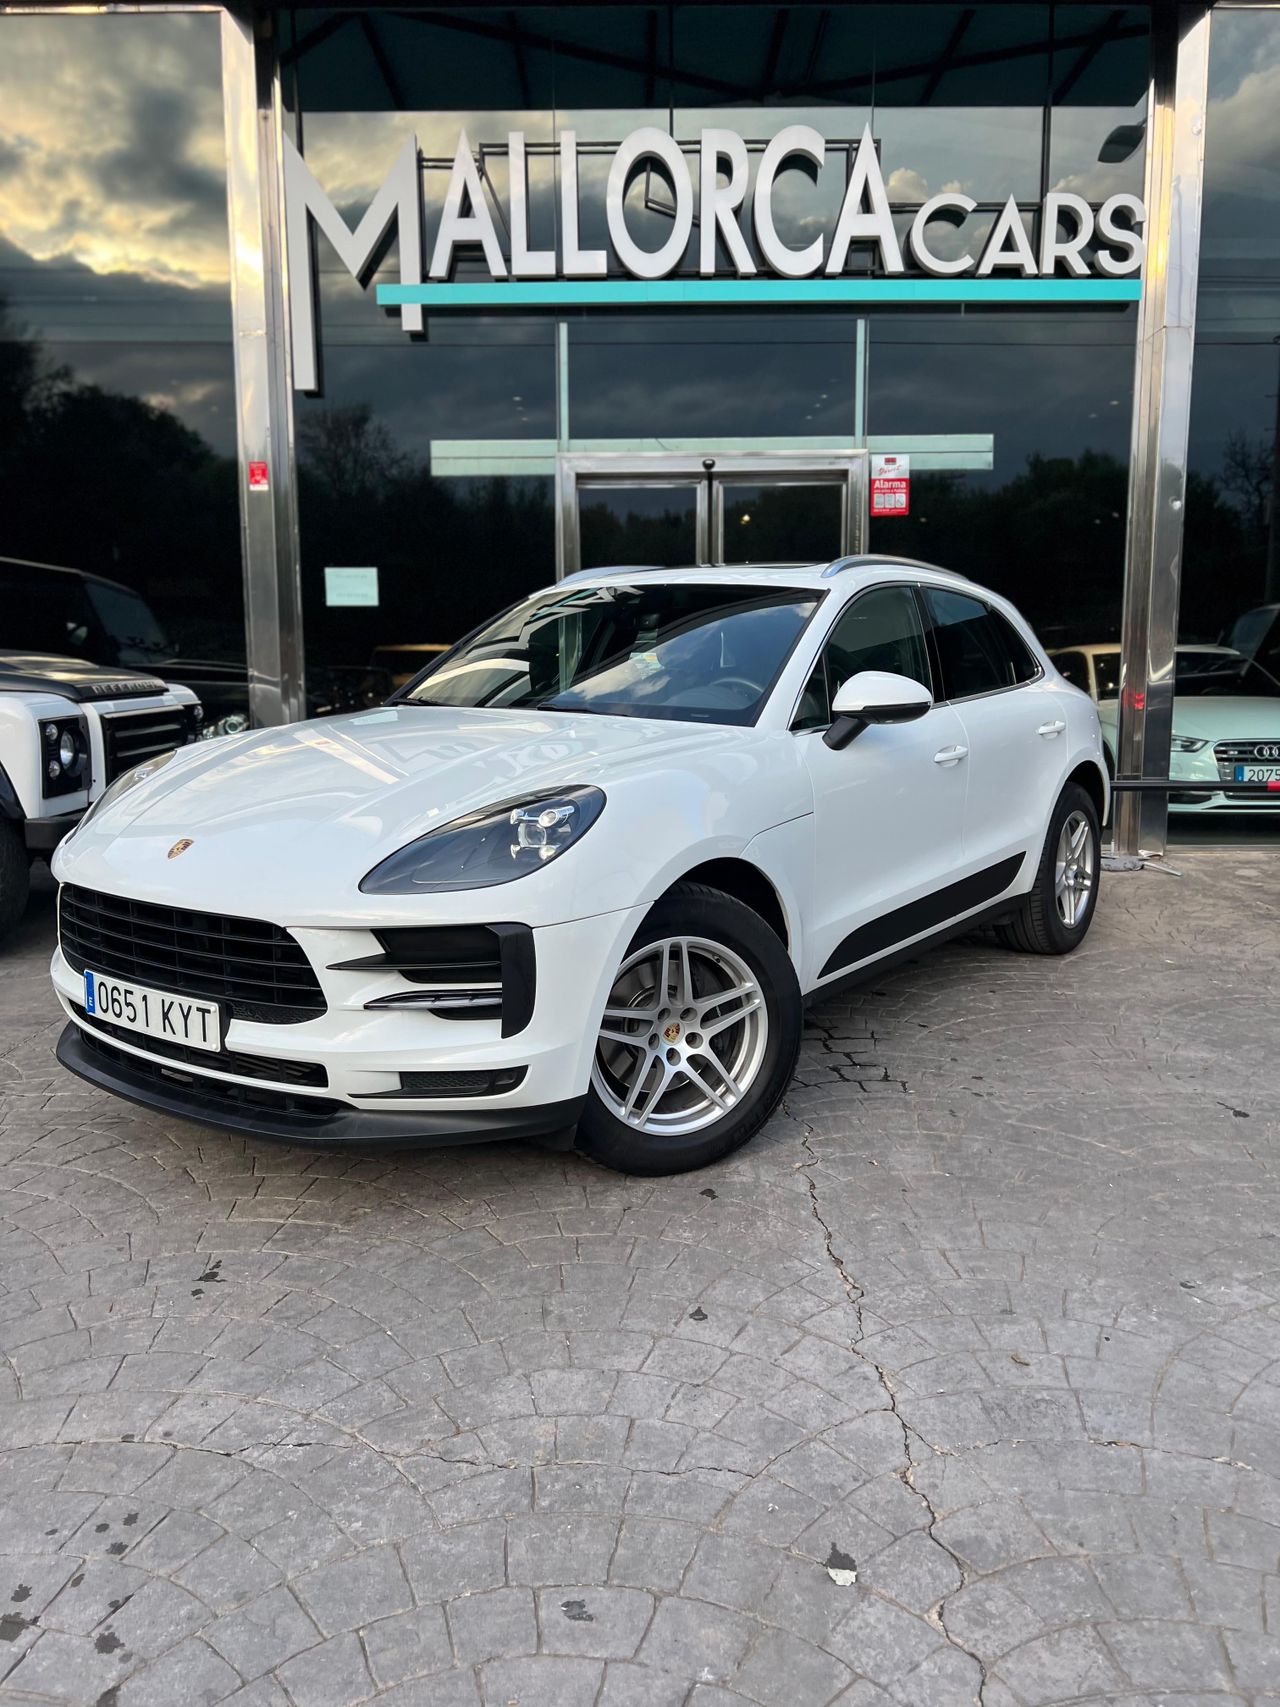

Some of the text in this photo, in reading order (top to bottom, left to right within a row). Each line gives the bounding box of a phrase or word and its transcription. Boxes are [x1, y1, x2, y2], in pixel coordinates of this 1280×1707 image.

[283, 121, 1146, 391] MALLORCA CARS
[874, 479, 906, 489] Alarma
[98, 981, 211, 1043] 0651 KYT
